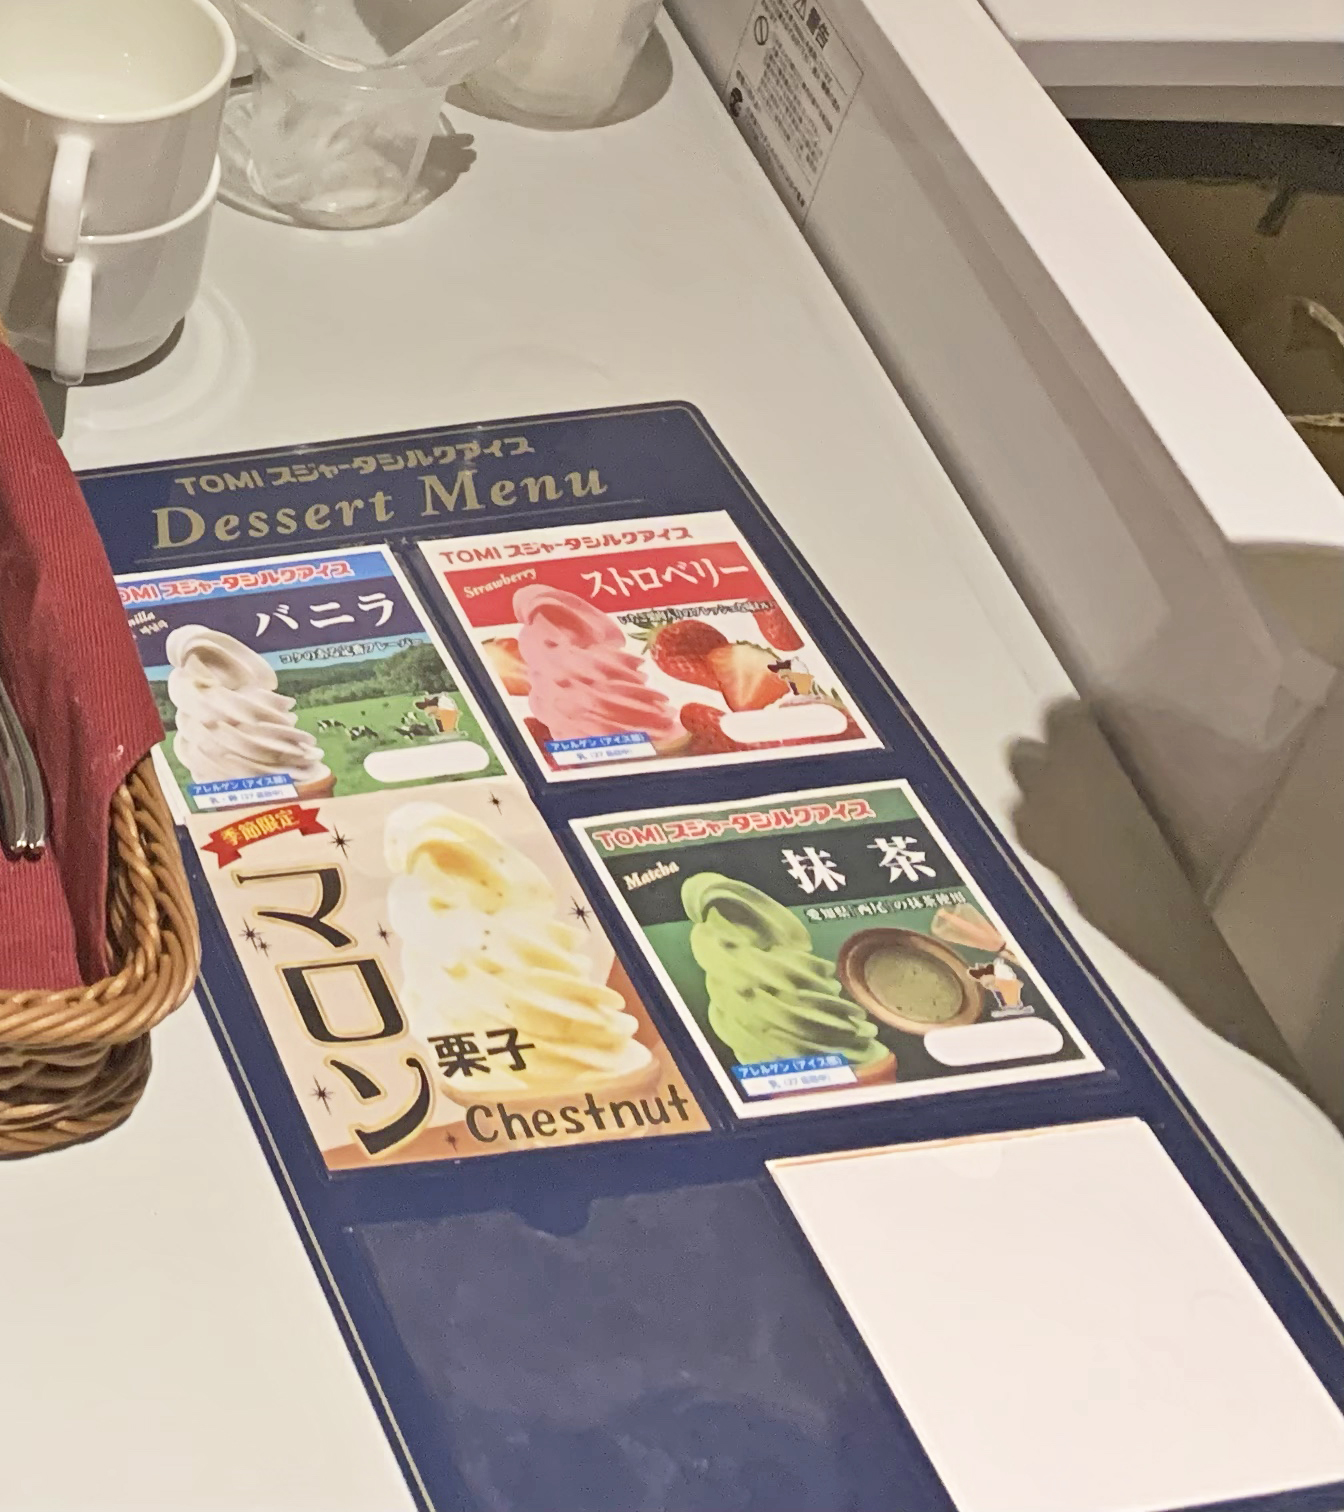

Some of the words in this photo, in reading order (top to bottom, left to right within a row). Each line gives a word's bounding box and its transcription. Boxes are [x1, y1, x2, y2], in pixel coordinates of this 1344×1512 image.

[175, 469, 263, 498] TOMI
[265, 436, 536, 487] スジャータシルクアイス
[152, 491, 396, 552] Dessert
[421, 463, 610, 518] Menu
[439, 549, 502, 566] TOMI
[507, 527, 694, 558] スジャータシルクアイス
[118, 585, 159, 603] OMI
[463, 567, 537, 599] Strawberry
[581, 558, 749, 599] ストロベリー
[256, 592, 394, 638] バニラ
[220, 809, 301, 846] 季節限定
[594, 824, 666, 850] TOMI
[622, 860, 680, 891] Matcha
[234, 865, 432, 1156] マロン
[429, 1028, 535, 1078] 栗子
[466, 1086, 691, 1144] Chestnut
